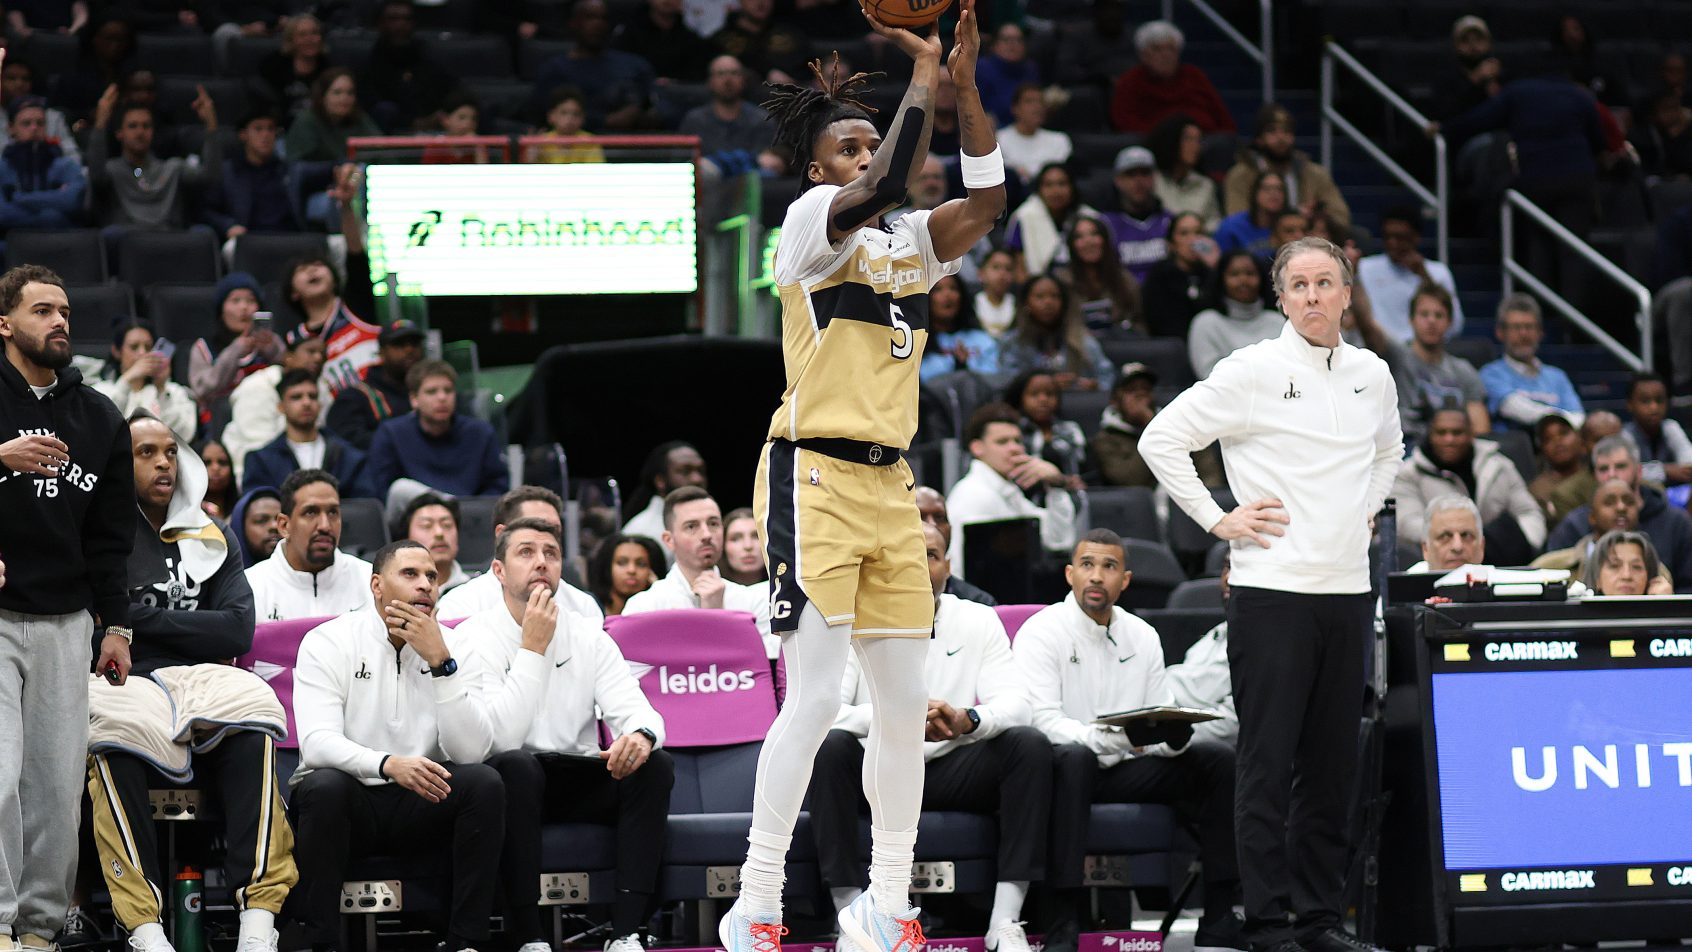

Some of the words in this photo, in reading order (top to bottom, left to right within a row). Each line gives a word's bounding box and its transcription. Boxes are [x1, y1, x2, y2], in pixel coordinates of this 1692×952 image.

[460, 208, 684, 247] Robinhood
[889, 301, 914, 360] 5
[33, 478, 59, 498] 75
[659, 663, 756, 695] leidos
[1511, 742, 1692, 792] UNIT
[1119, 937, 1162, 952] leidos
